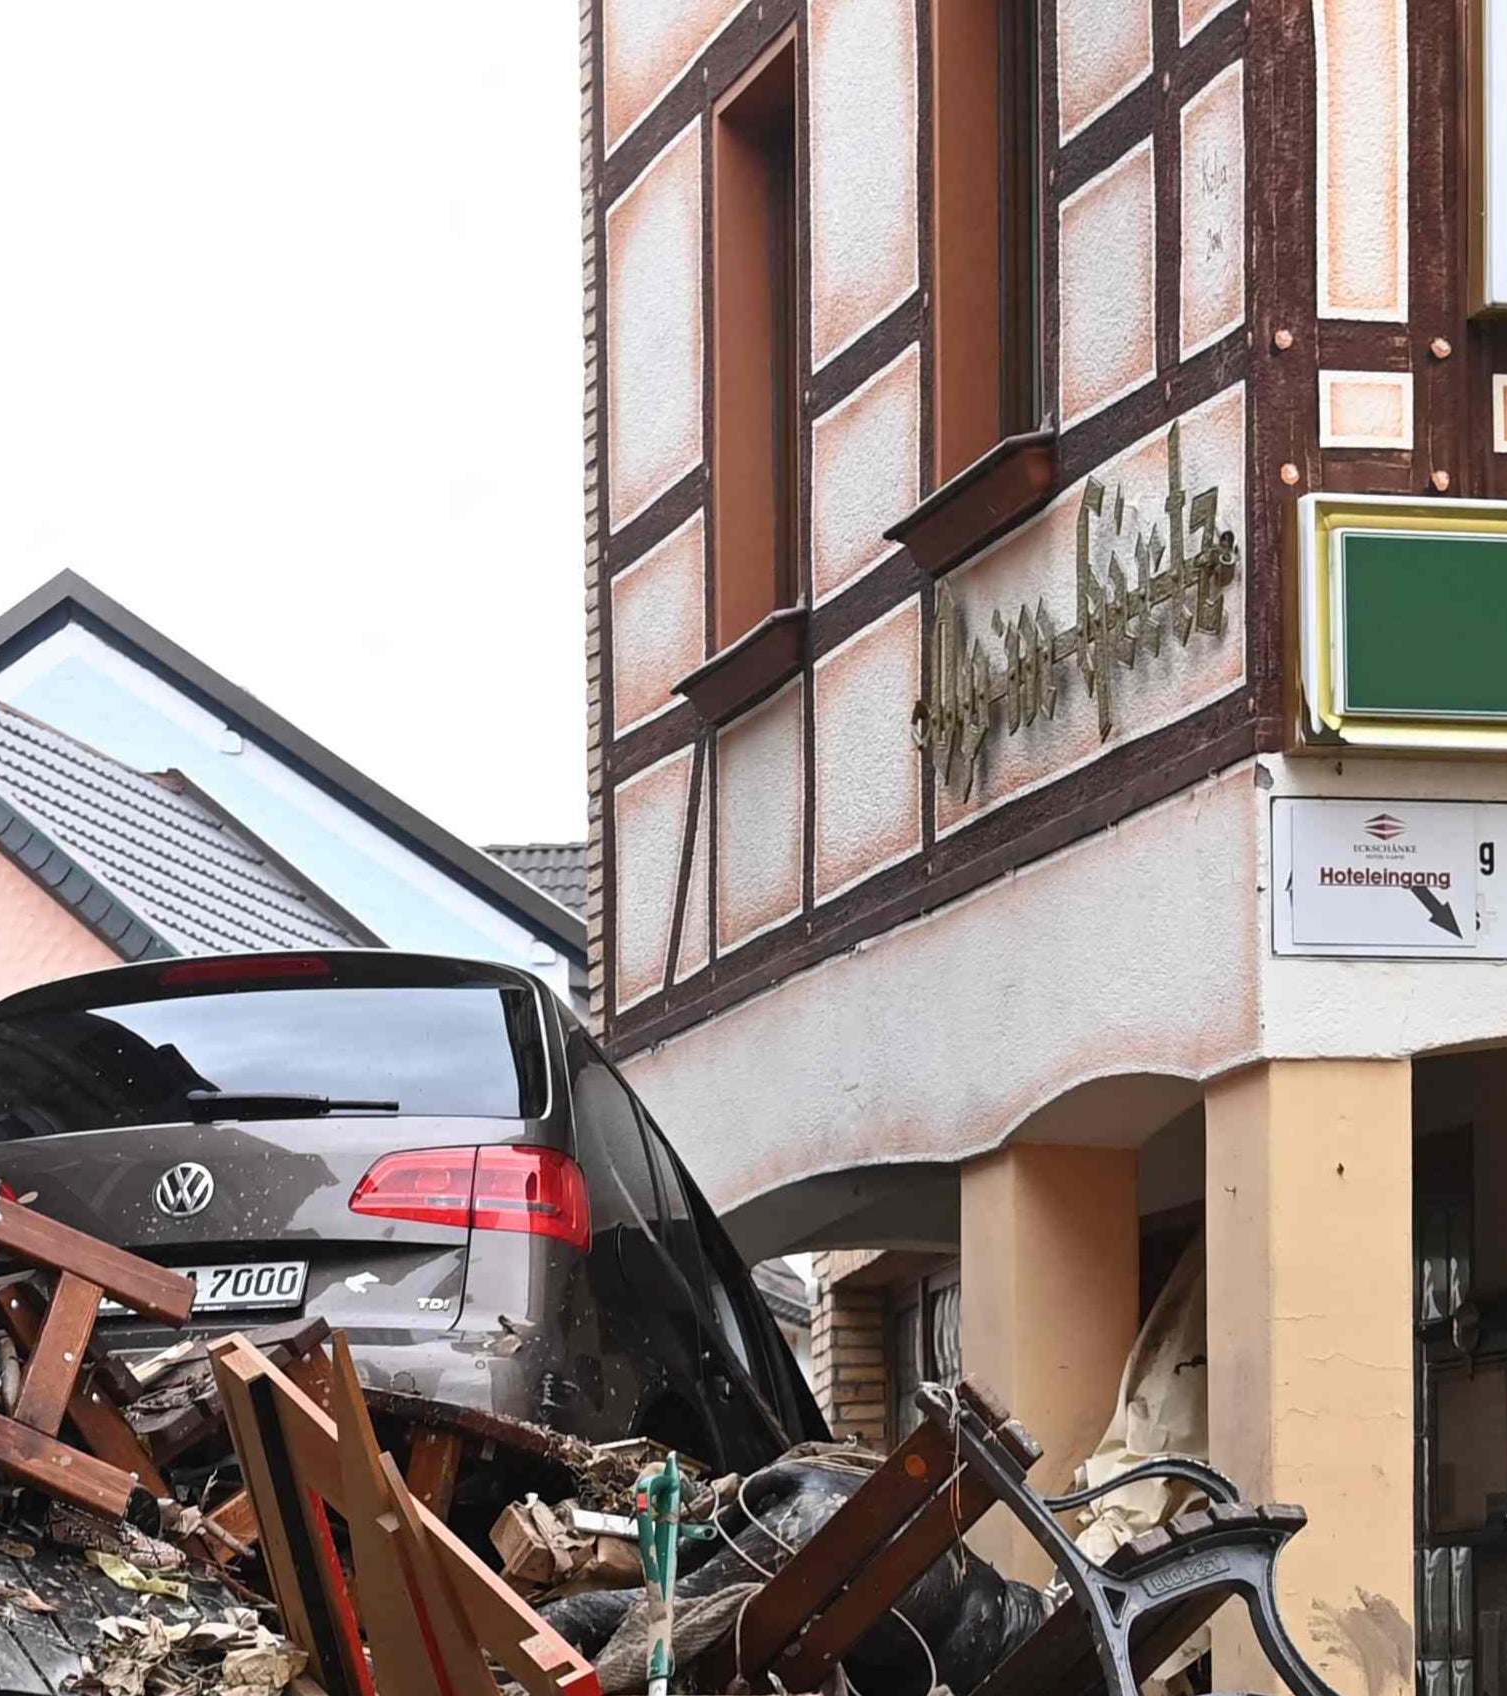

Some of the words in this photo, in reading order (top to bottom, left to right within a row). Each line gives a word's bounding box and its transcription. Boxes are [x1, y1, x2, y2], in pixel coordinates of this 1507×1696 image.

[1319, 866, 1451, 889] Hoteleingang
[209, 1266, 298, 1299] 7000
[417, 1297, 451, 1310] TDI
[1152, 1553, 1226, 1592] BUDAPEST
